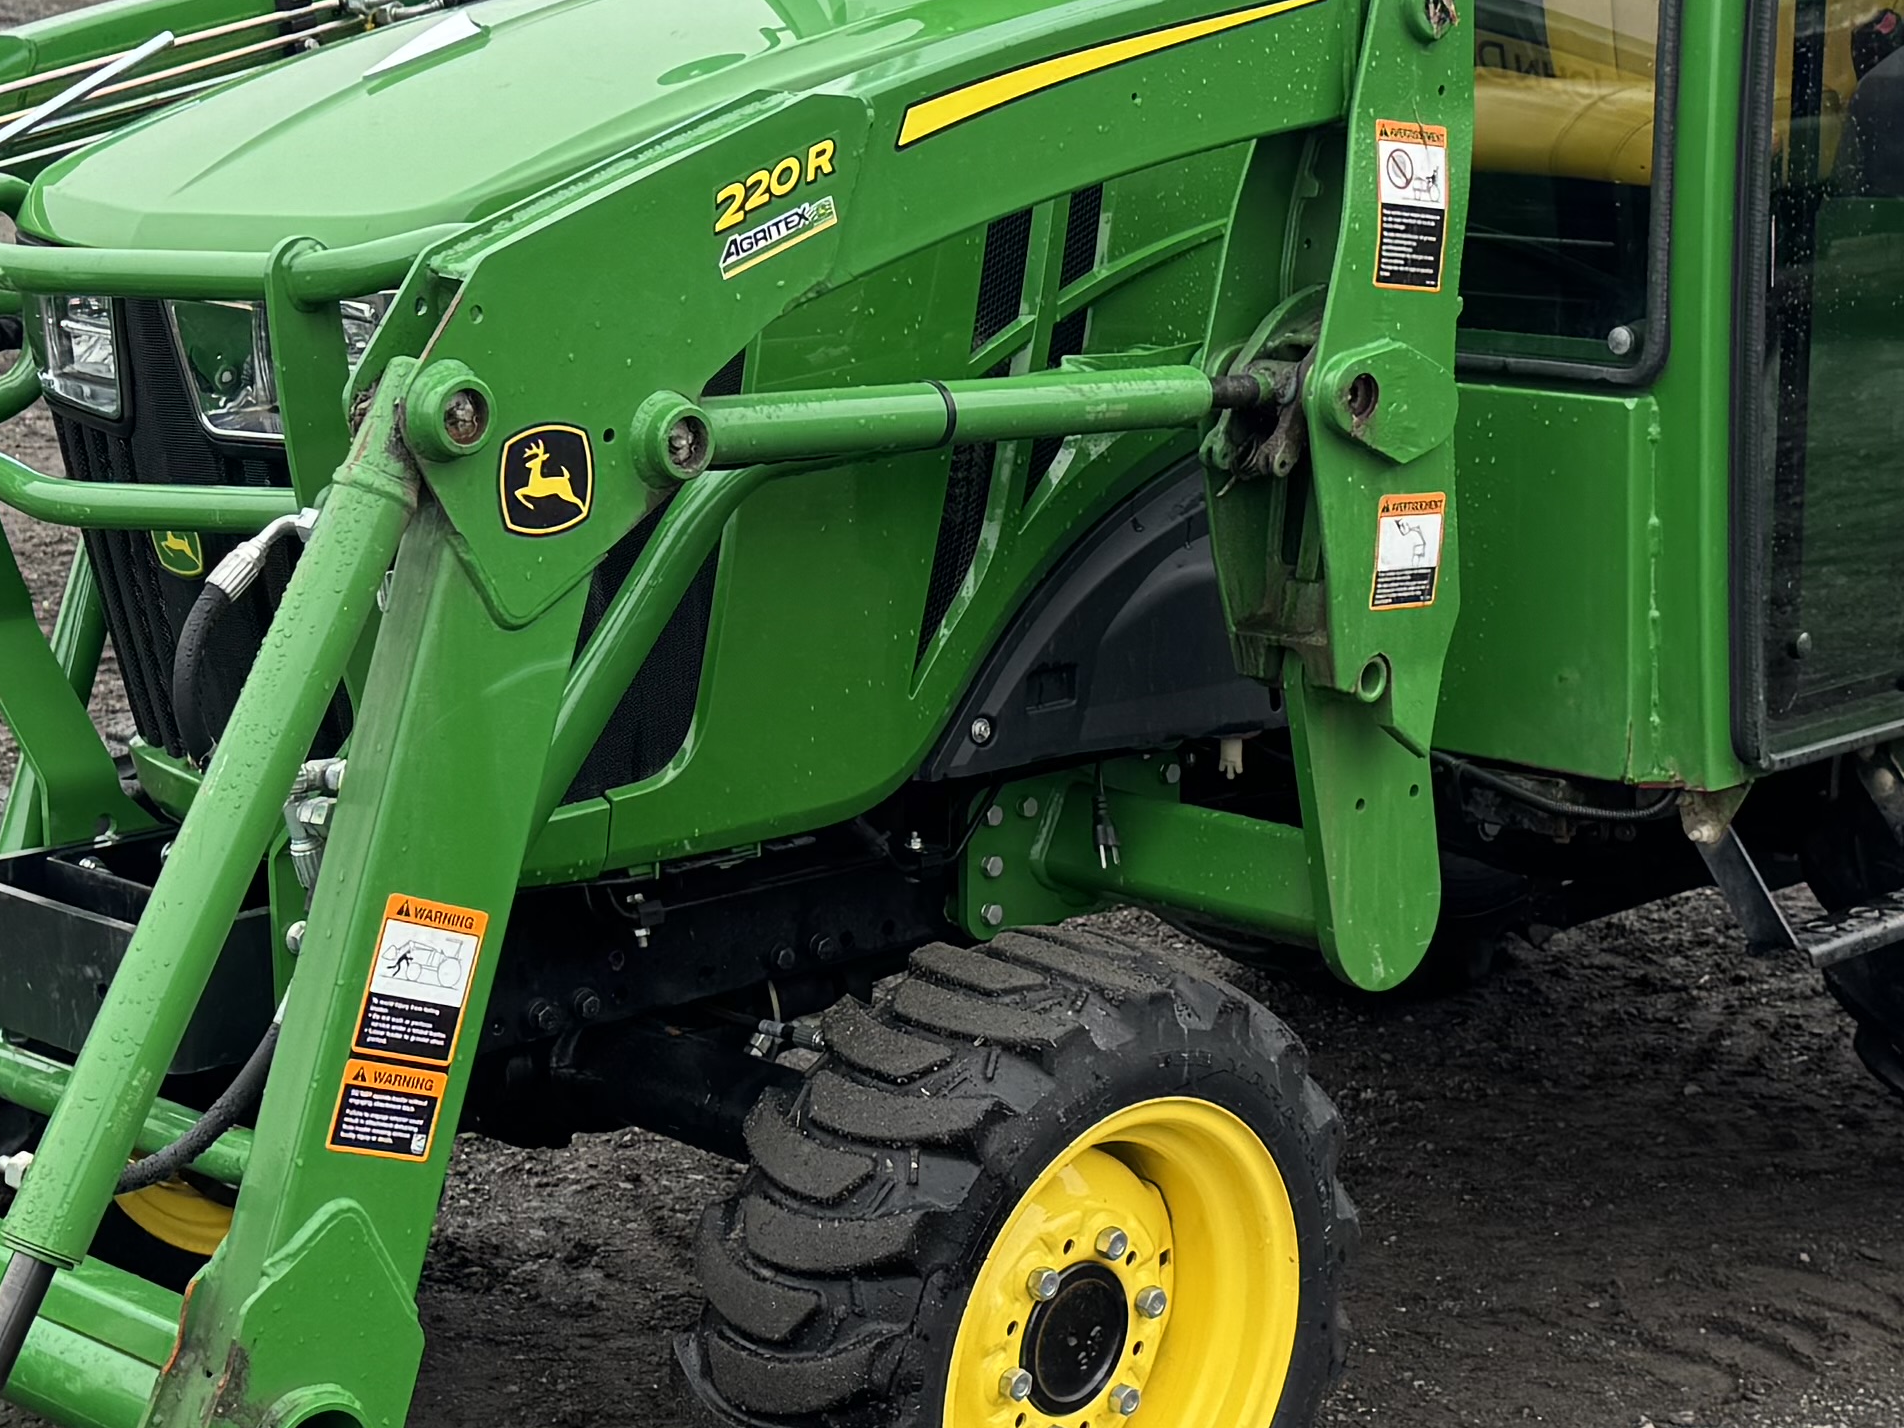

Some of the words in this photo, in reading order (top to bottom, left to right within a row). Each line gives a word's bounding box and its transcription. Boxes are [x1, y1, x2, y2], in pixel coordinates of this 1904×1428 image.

[714, 155, 802, 235] 220
[722, 207, 810, 264] AGRITEX
[414, 906, 474, 930] WARNING
[373, 1071, 434, 1091] WARNING
